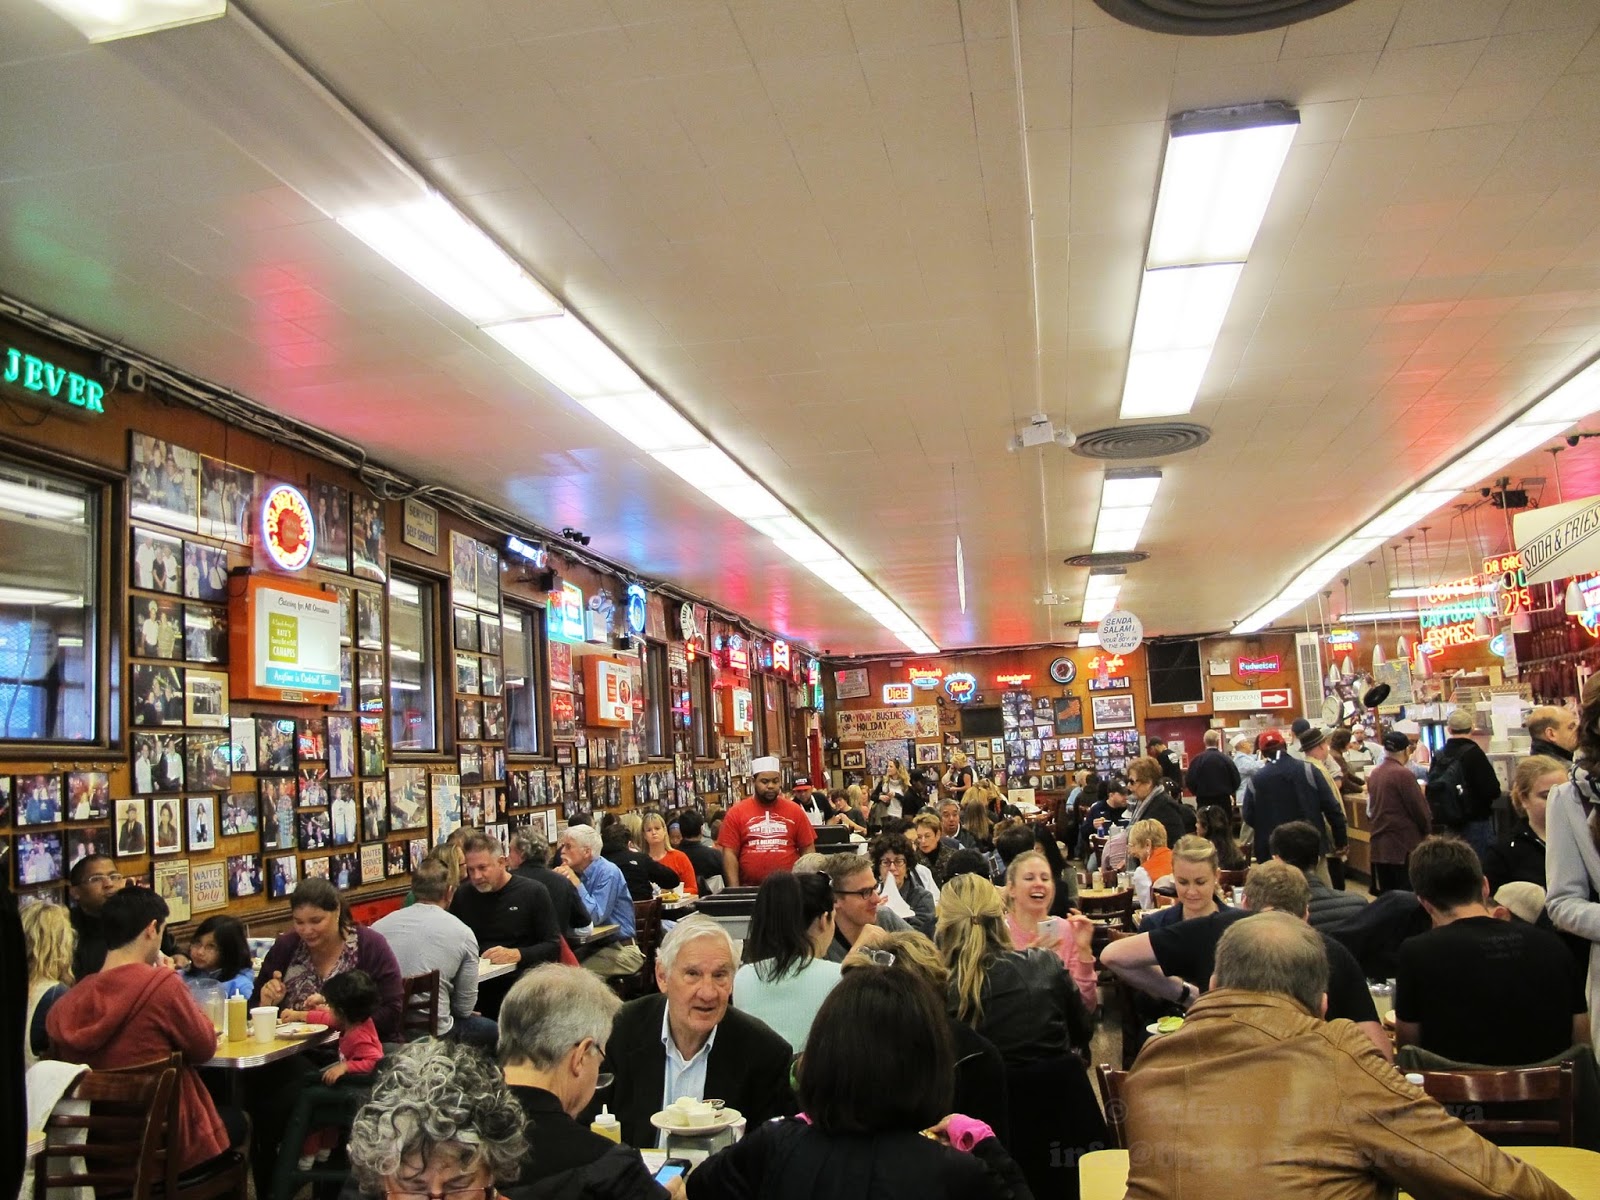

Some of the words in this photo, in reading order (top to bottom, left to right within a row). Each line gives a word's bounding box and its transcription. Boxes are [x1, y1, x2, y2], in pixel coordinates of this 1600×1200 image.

[4, 348, 105, 413] JEVER
[1524, 534, 1552, 571] SODA
[1554, 528, 1562, 551] &
[1564, 506, 1600, 546] FRIES
[1484, 560, 1500, 575] DR
[1427, 576, 1479, 603] COFFEE
[1103, 624, 1136, 634] SALAMI
[1334, 643, 1353, 651] BEER
[1240, 662, 1277, 671] Budweiser
[949, 681, 971, 692] Pabst
[1215, 694, 1260, 702] RESTROOMS
[840, 714, 853, 723] FOR
[855, 712, 872, 722] YOUR
[876, 710, 912, 721] BUSINESS
[856, 721, 888, 732] HOLIDAY
[362, 849, 382, 859] WAITER
[362, 857, 382, 867] SERVICE
[193, 868, 223, 881] WAITER
[363, 866, 380, 876] Only
[193, 879, 224, 893] SERVICE
[196, 890, 221, 902] Only
